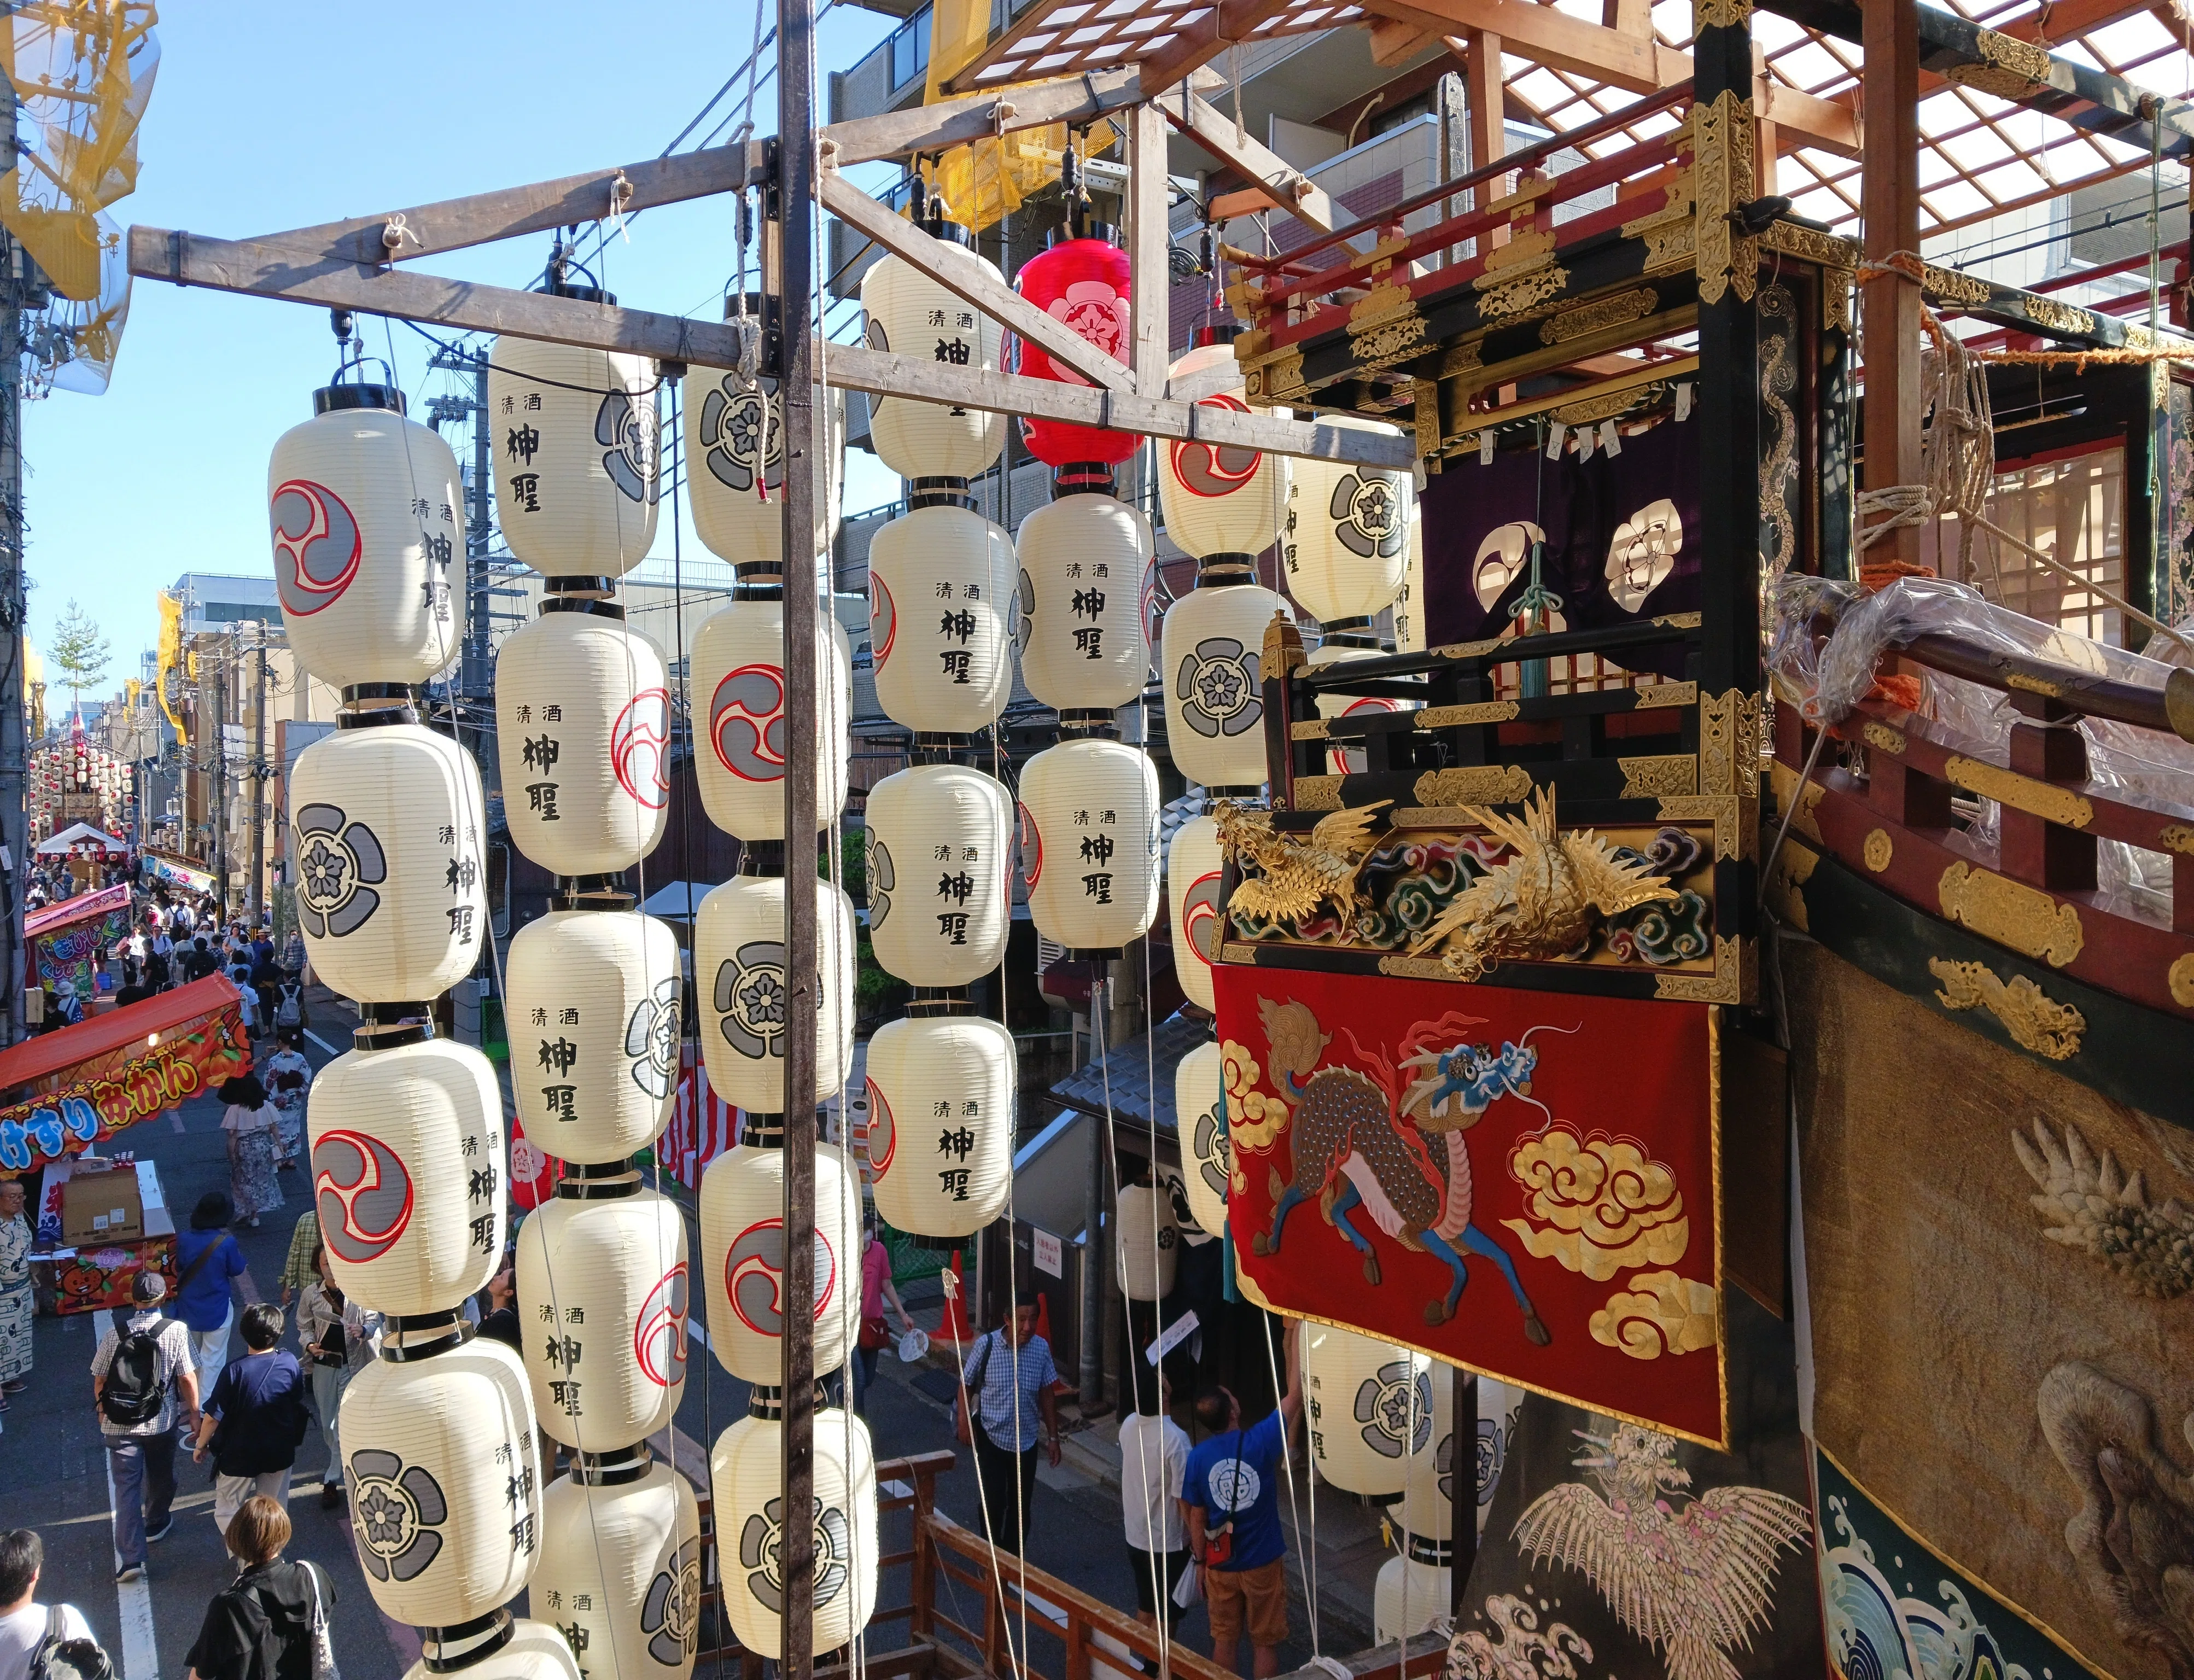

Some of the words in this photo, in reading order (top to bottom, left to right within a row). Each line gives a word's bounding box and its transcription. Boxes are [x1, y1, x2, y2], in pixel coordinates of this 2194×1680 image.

[928, 310, 973, 329] 清酒
[501, 393, 541, 415] 清酒
[506, 423, 540, 513] 神聖
[412, 498, 453, 523] 清酒
[418, 531, 452, 622] 神聖
[1066, 563, 1108, 579] 清酒
[936, 582, 981, 600] 清酒
[1071, 587, 1105, 660] 神聖
[936, 609, 977, 684] 神聖
[517, 704, 562, 724] 清酒
[522, 733, 561, 821] 神聖
[1074, 809, 1116, 826] 清酒
[439, 825, 478, 845] 清酒
[935, 844, 978, 863] 清酒
[1076, 833, 1114, 905] 神聖
[441, 854, 476, 945] 神聖
[935, 871, 975, 946] 神聖
[532, 1008, 579, 1028] 清酒
[851, 1060, 867, 1068] ニン
[536, 1037, 579, 1122] 神聖
[933, 1101, 978, 1118] 清酒
[462, 1131, 498, 1156] 清酒
[937, 1128, 975, 1201] 神聖
[468, 1164, 497, 1255] 神聖
[539, 1305, 585, 1325] 清酒
[544, 1334, 583, 1417] 神聖
[495, 1431, 532, 1465] 清酒
[504, 1465, 536, 1558] 神聖
[547, 1591, 592, 1612] 清酒
